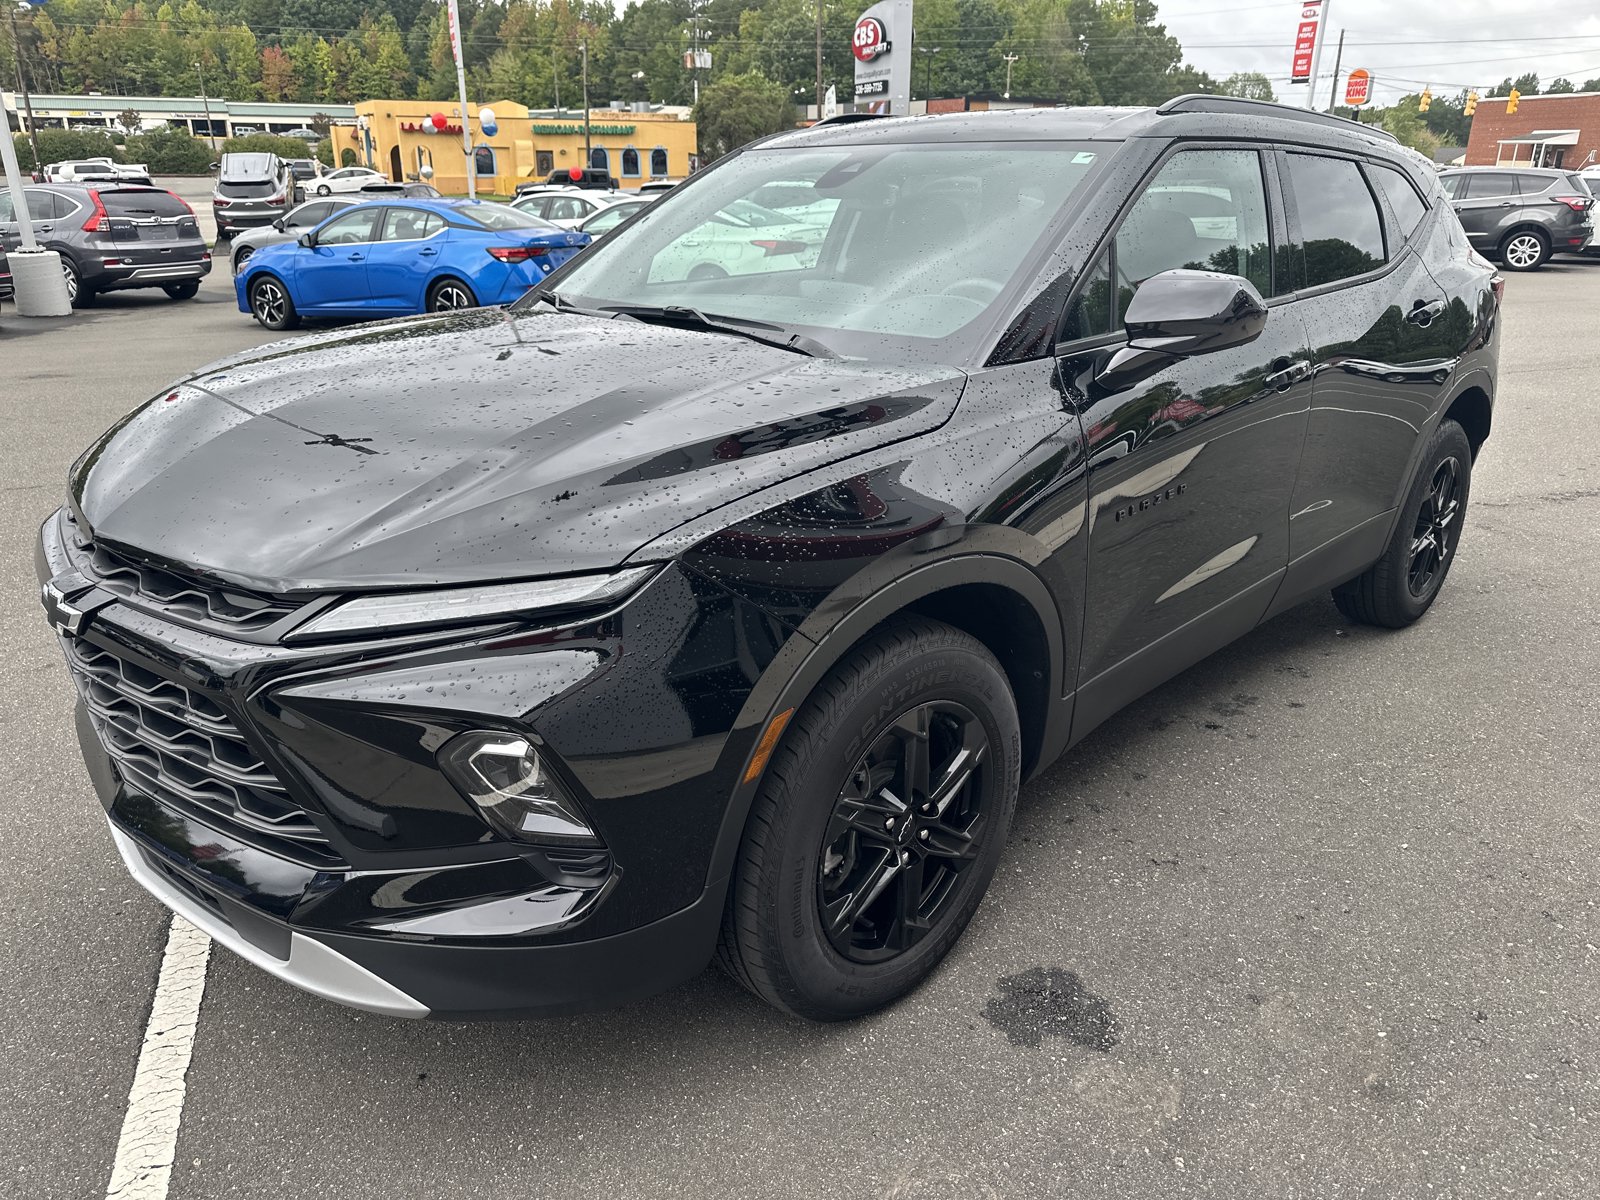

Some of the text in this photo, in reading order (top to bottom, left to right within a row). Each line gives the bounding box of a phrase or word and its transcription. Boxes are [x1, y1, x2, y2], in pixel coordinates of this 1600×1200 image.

[854, 24, 874, 47] CBS
[1348, 79, 1368, 87] BURGER
[1346, 87, 1367, 98] KING
[401, 122, 415, 131] LA
[532, 124, 575, 134] MEXICAN
[1115, 483, 1187, 522] BLAZER
